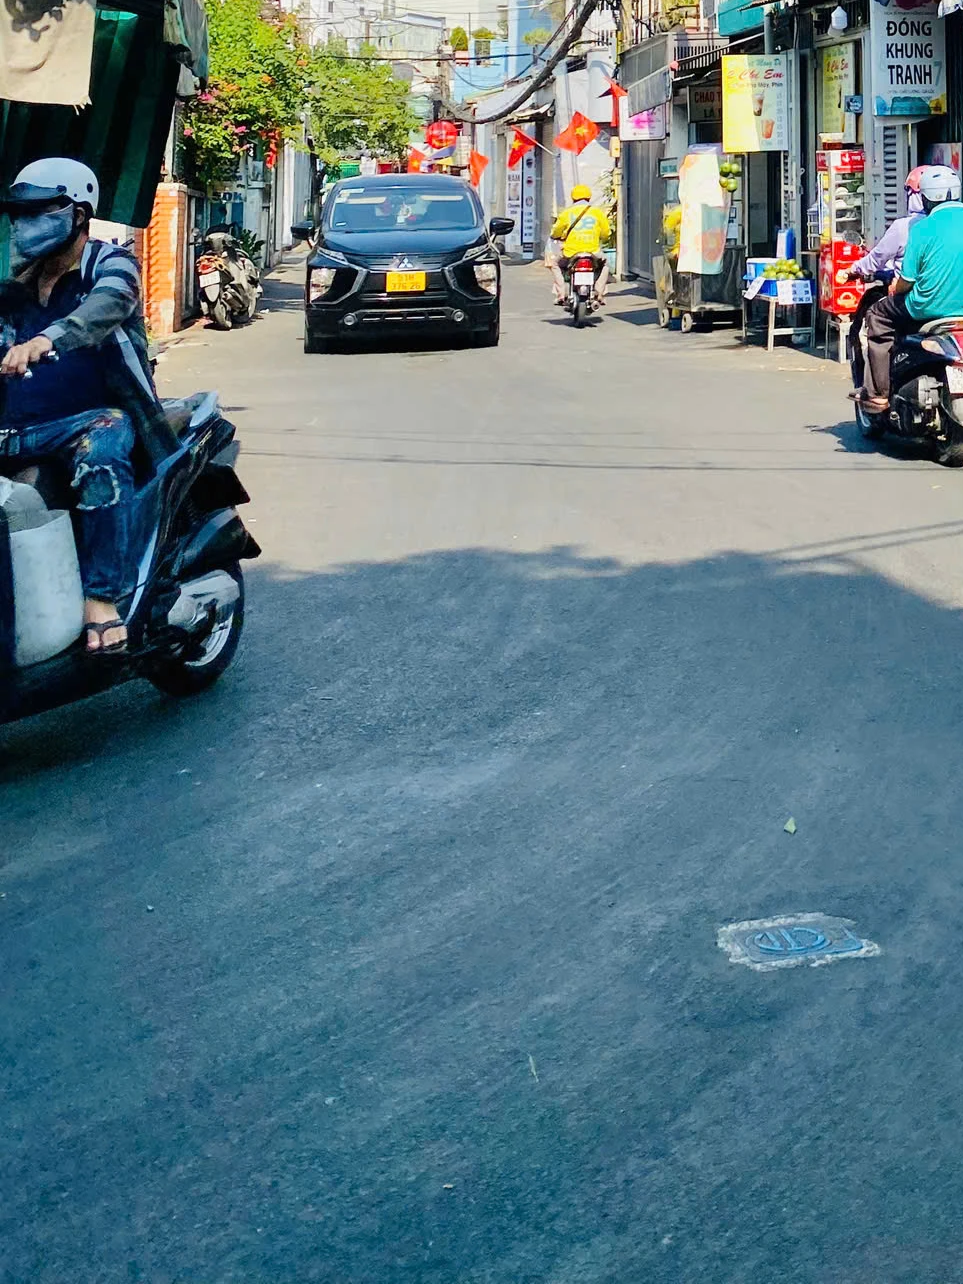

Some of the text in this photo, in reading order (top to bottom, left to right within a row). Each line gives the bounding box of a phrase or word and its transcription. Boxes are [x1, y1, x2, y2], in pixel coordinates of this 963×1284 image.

[886, 16, 932, 37] ĐÓNG
[886, 43, 933, 59] KHUNG
[887, 64, 932, 85] TRANH
